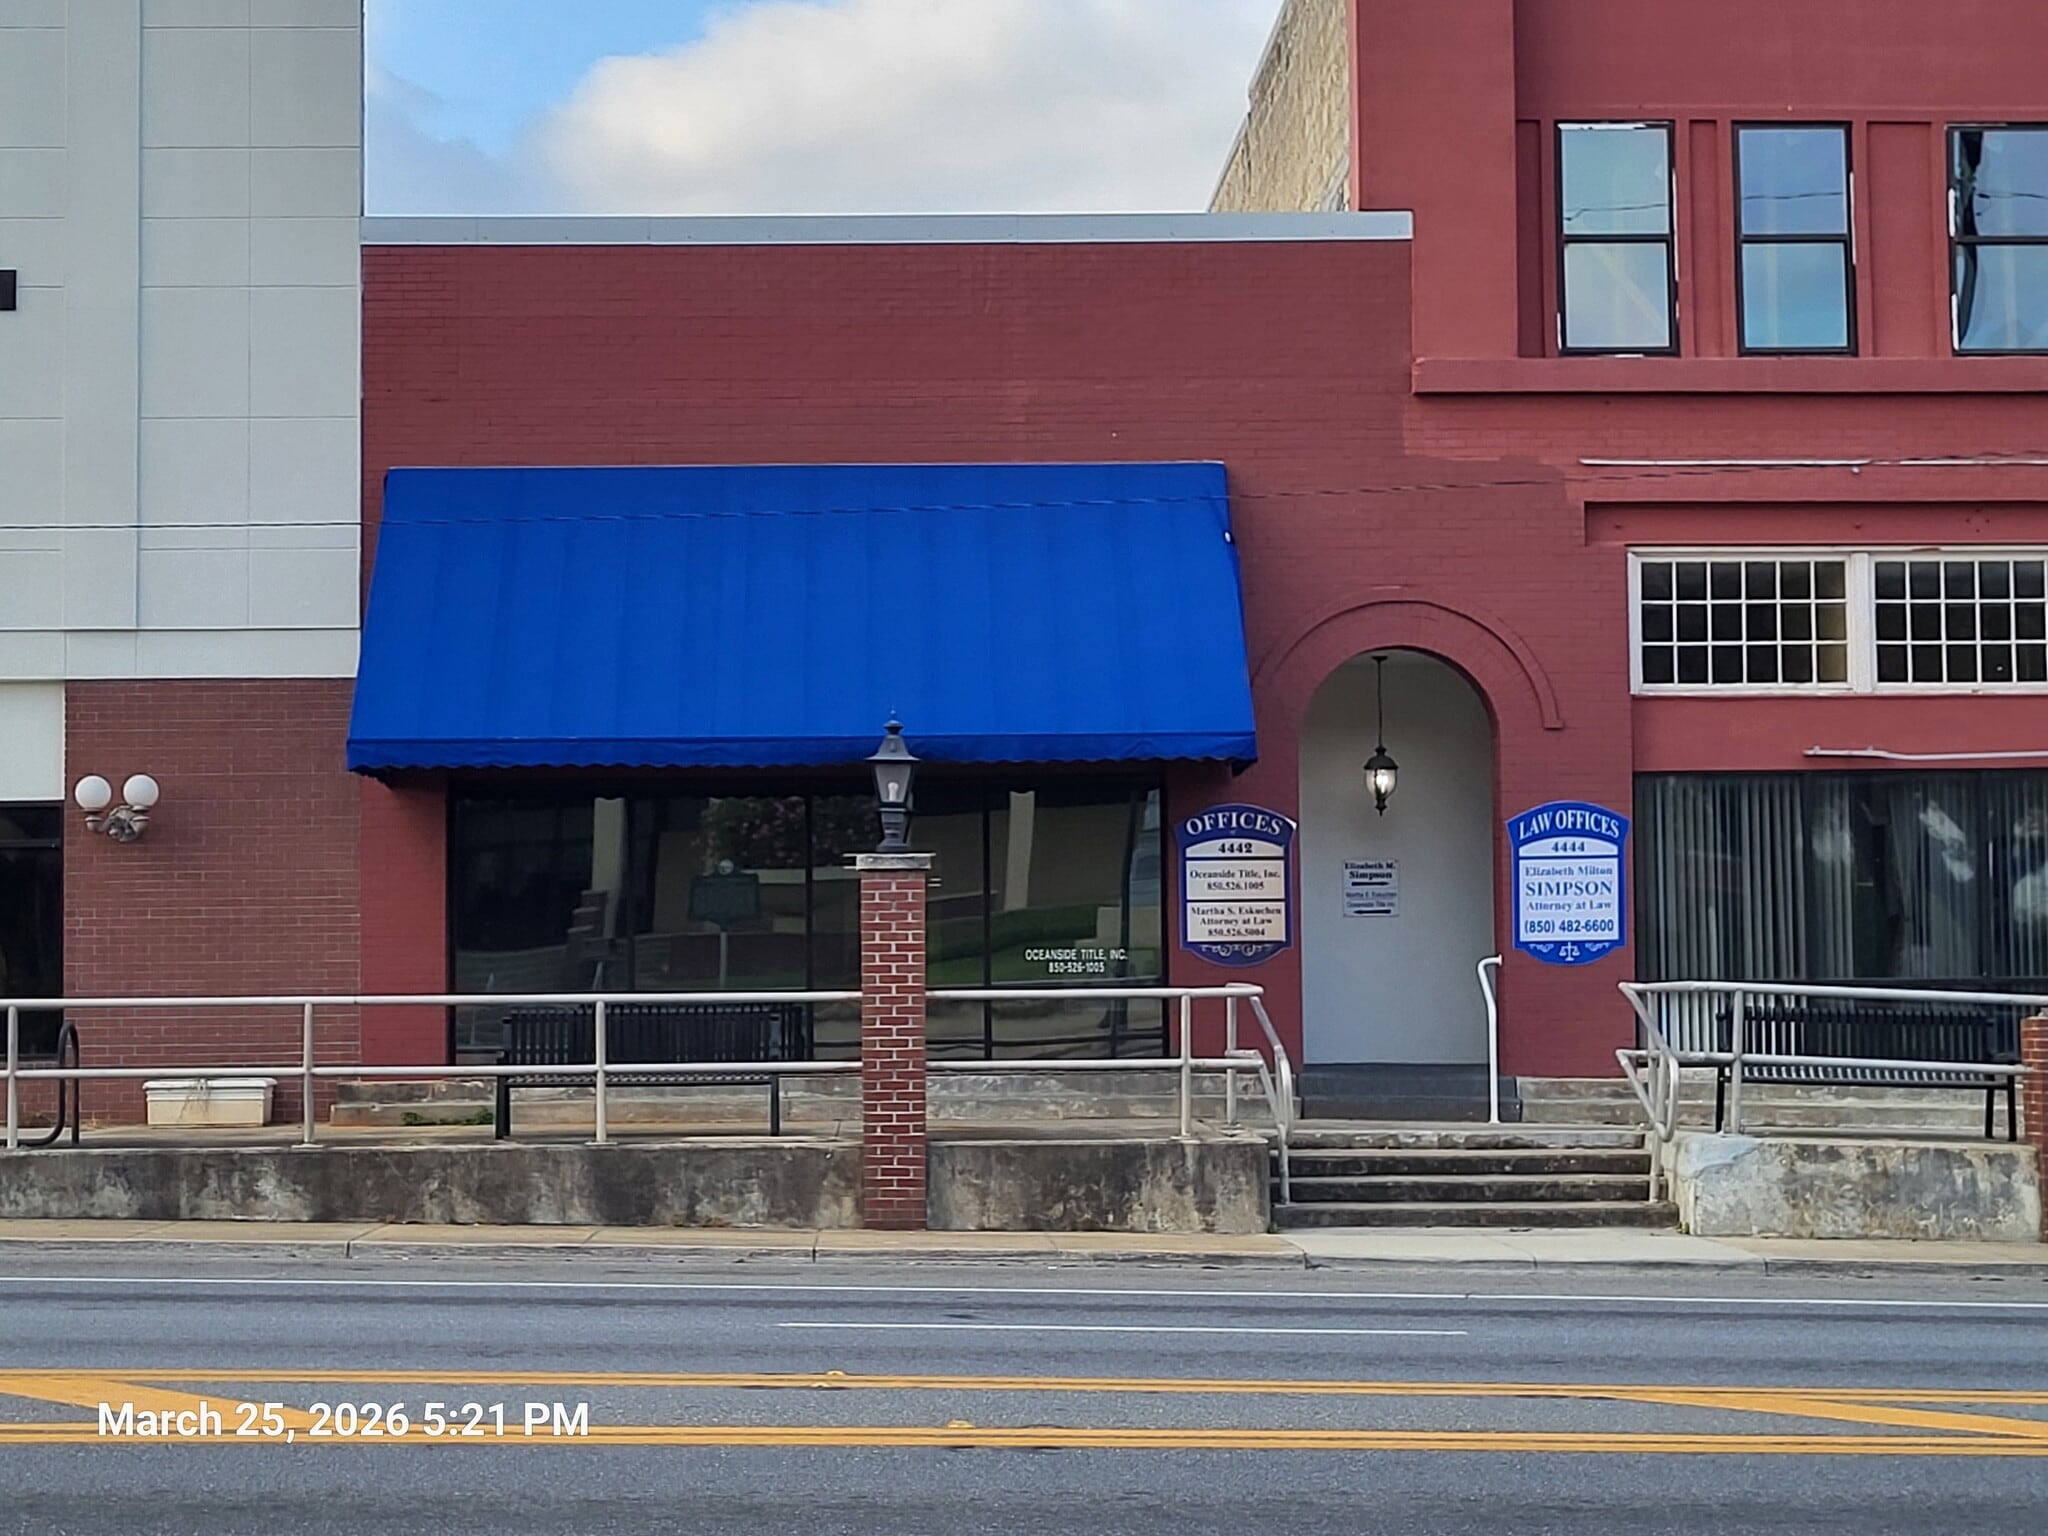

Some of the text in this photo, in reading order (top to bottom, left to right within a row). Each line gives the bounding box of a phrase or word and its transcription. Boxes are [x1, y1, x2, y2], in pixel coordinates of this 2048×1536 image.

[1186, 812, 1283, 835] OFFICES
[1519, 809, 1620, 840] LAW OFFICES
[1218, 843, 1253, 853] 4442
[1551, 842, 1585, 852] 4444
[1190, 869, 1235, 879] Oceanside
[1264, 869, 1280, 879] Inc.
[1349, 871, 1392, 880] Simpson
[1525, 866, 1613, 877] Elizabeth Milton
[1207, 881, 1264, 890] 850.526.1005
[1526, 881, 1612, 897] SIMPSON
[1191, 907, 1224, 915] Martha
[1526, 900, 1611, 912] Attorney at Law
[1200, 917, 1239, 926] Attorney
[1253, 917, 1272, 925] Law
[1524, 919, 1614, 934] (850) 482-6600
[1025, 949, 1077, 960] OCEANSIDE
[1110, 949, 1128, 960] INC.
[1048, 962, 1105, 973] 850-526-1005
